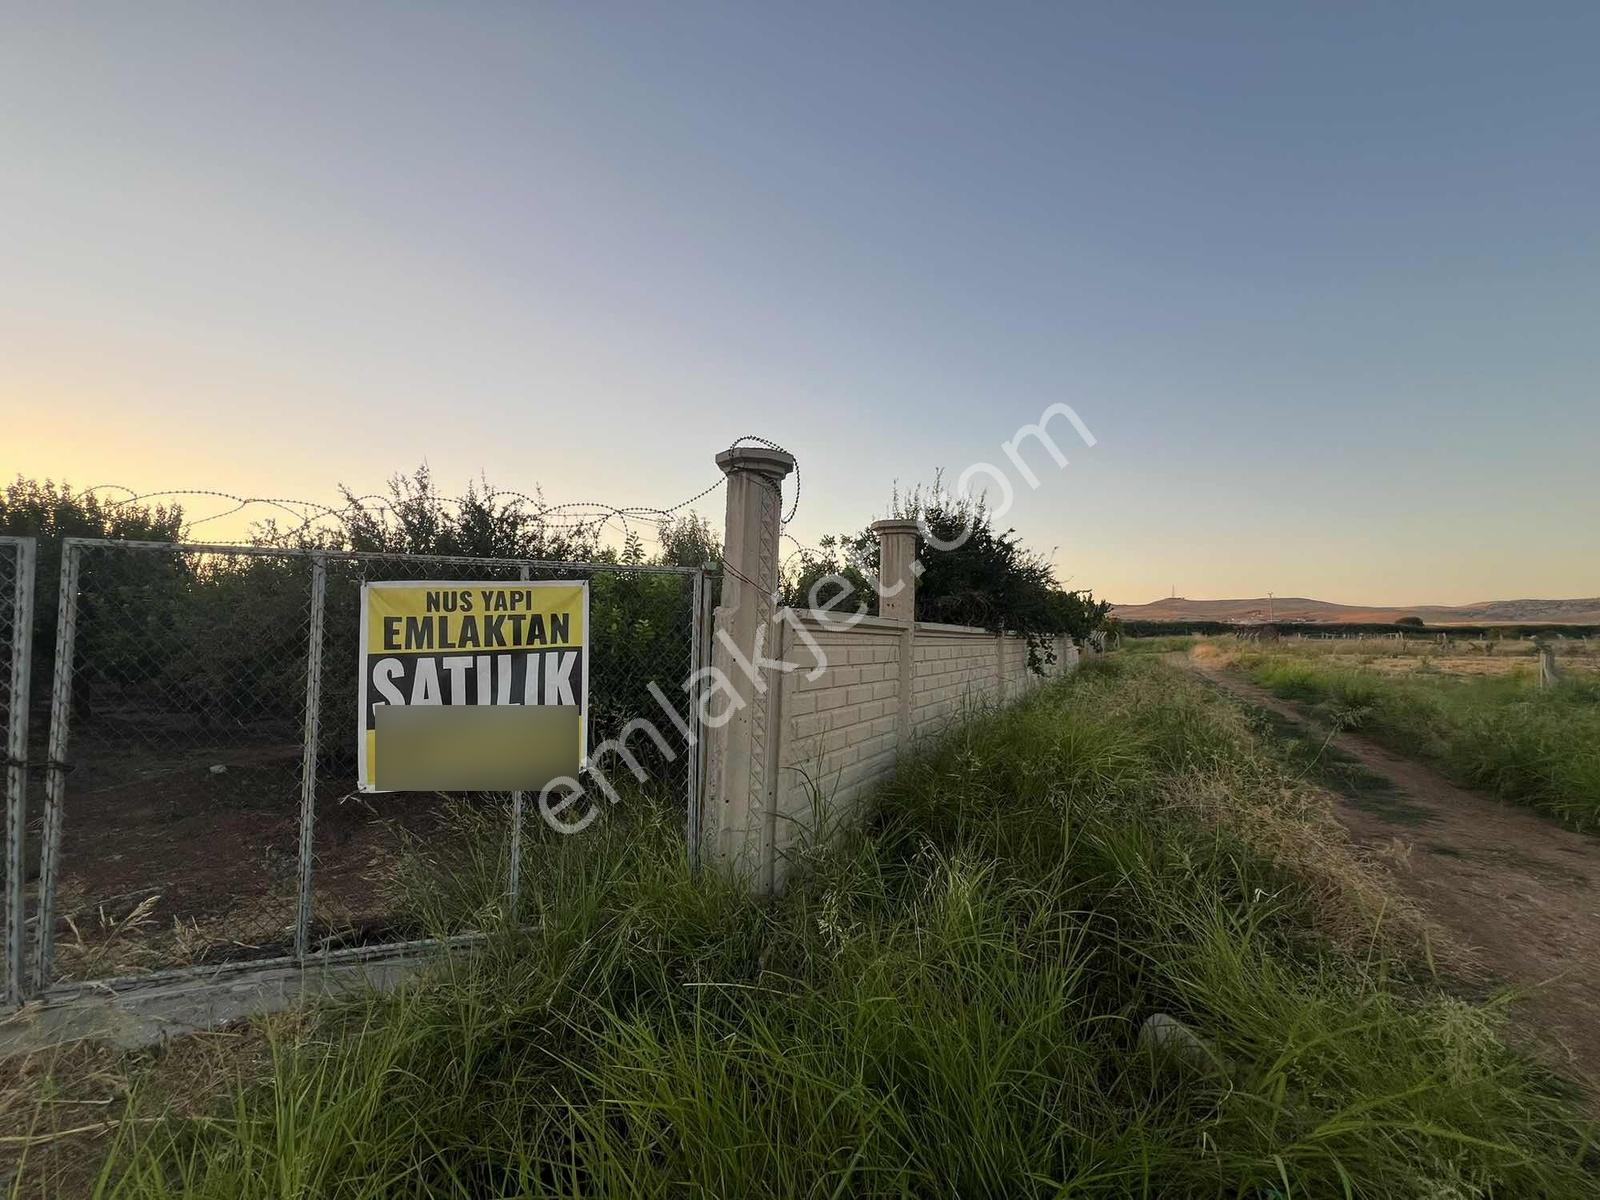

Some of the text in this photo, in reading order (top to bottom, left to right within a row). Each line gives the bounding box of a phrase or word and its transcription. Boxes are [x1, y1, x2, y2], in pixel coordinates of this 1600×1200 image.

[426, 590, 532, 612] NUS YAPI
[383, 613, 569, 650] EMLAKTAN
[372, 651, 578, 706] SATILIK
